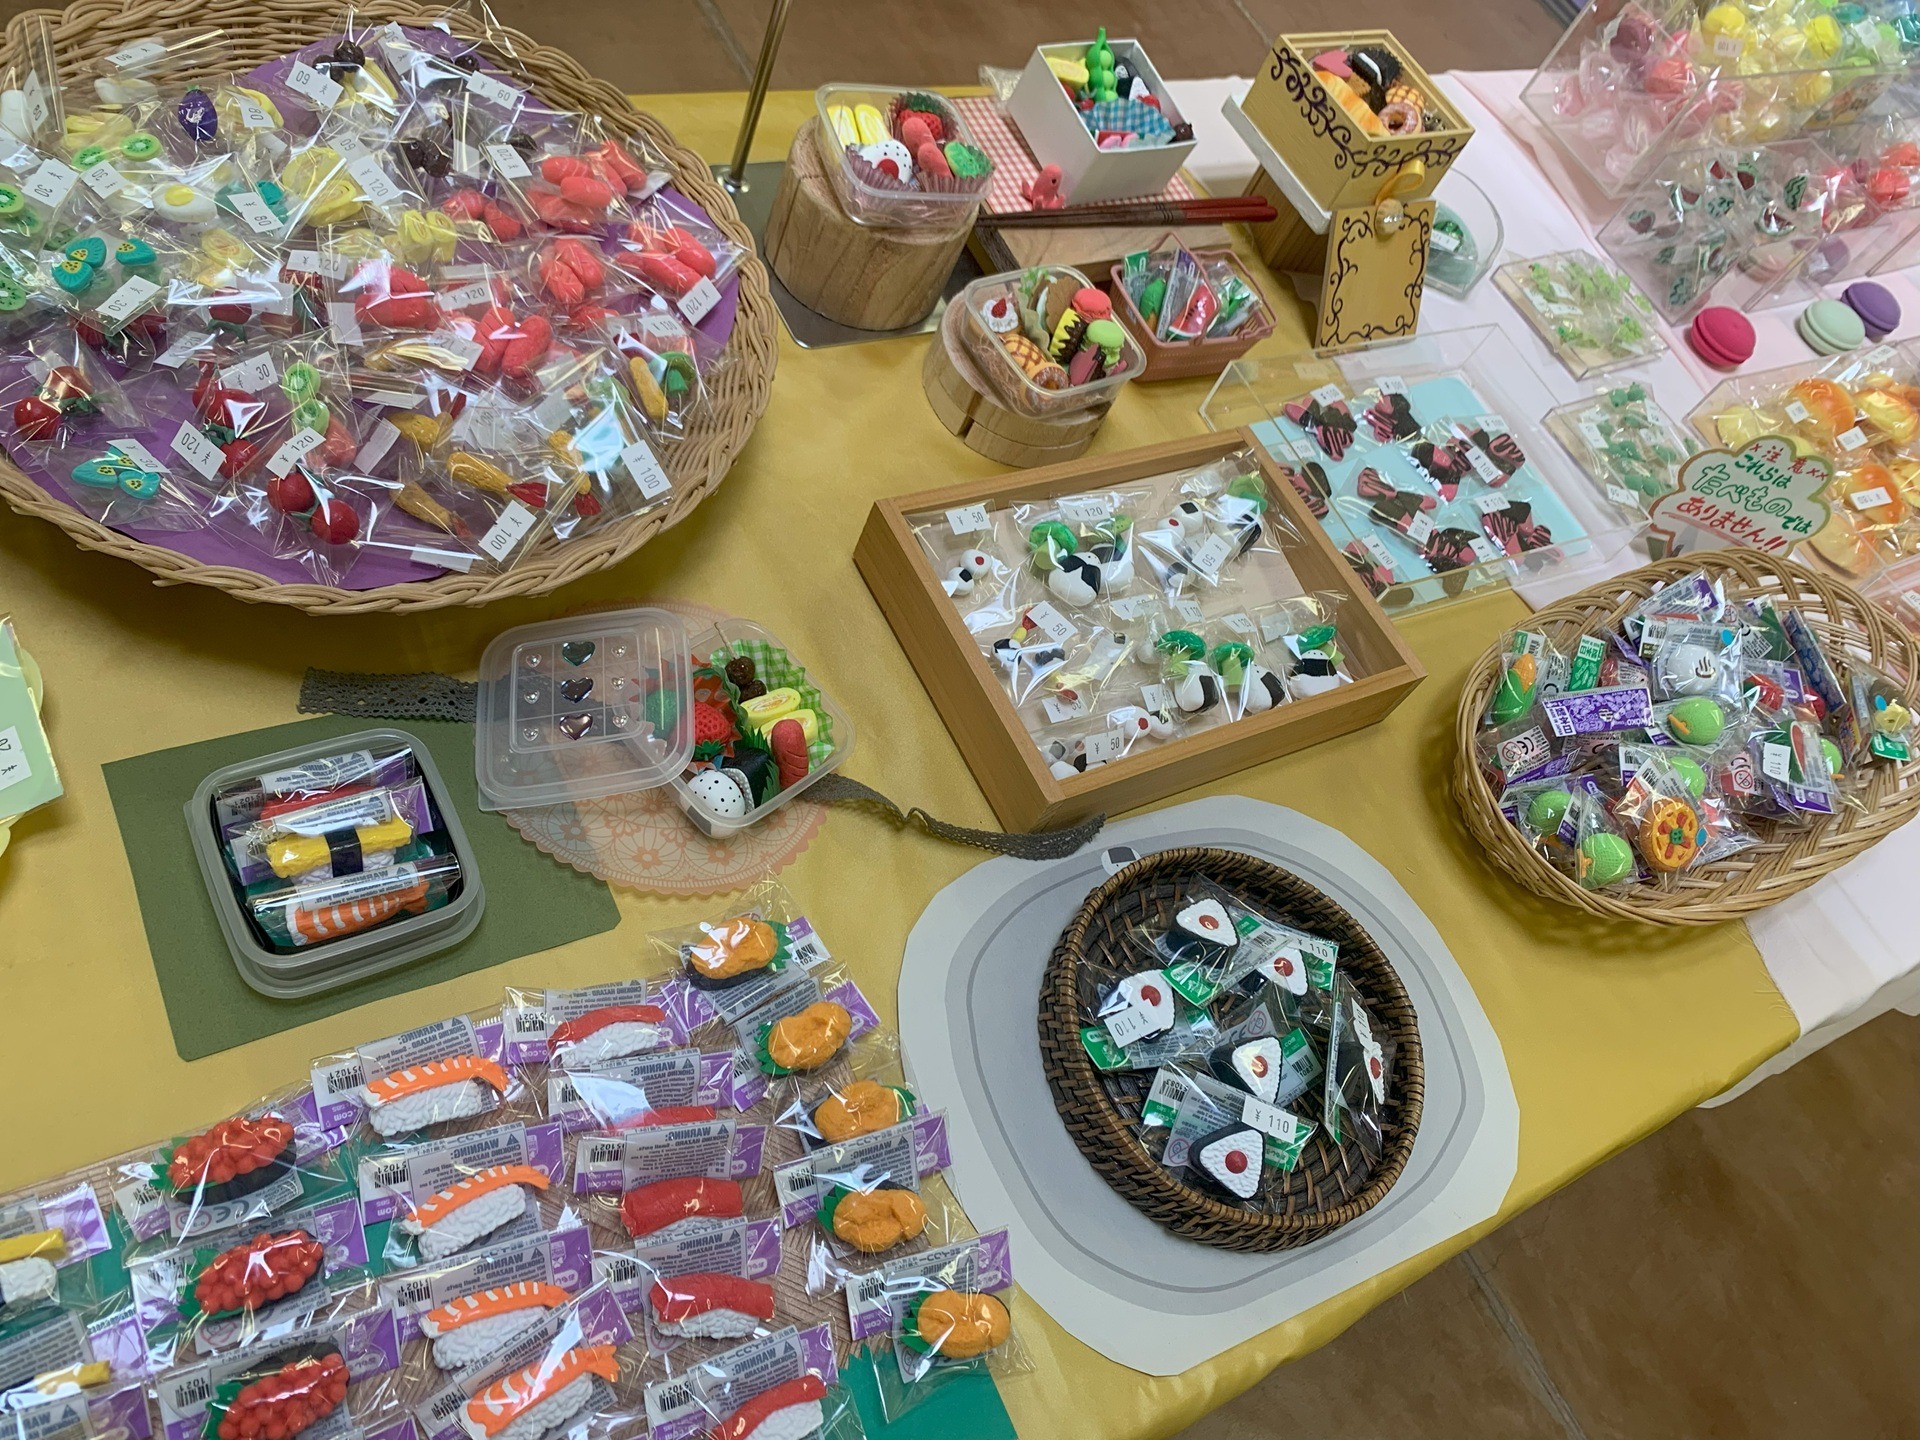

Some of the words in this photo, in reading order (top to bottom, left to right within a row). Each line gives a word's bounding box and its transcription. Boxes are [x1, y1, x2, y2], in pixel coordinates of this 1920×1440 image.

[295, 70, 311, 86] 60
[497, 89, 511, 101] 60
[248, 107, 264, 121] 80
[91, 168, 109, 181] 30
[34, 184, 53, 198] 30
[368, 178, 389, 198] 120
[318, 258, 340, 272] 120
[465, 287, 485, 300] 120
[108, 299, 128, 312] 30
[685, 296, 703, 316] 120
[255, 364, 270, 380] 30
[181, 432, 200, 455] 120
[291, 434, 315, 453] 120
[640, 466, 660, 490] 100
[1735, 454, 1793, 489] これらは
[1692, 463, 1793, 517] たべもの
[972, 511, 984, 524] 50
[1084, 506, 1103, 517] 120
[1781, 514, 1813, 534] では
[490, 528, 512, 550] 100
[1202, 554, 1216, 567] 50
[1052, 624, 1067, 637] 50
[1110, 736, 1120, 751] 50
[1769, 761, 1782, 776] 110
[1309, 943, 1328, 957] 110
[1114, 1017, 1136, 1037] 110
[1268, 1114, 1290, 1134] 110
